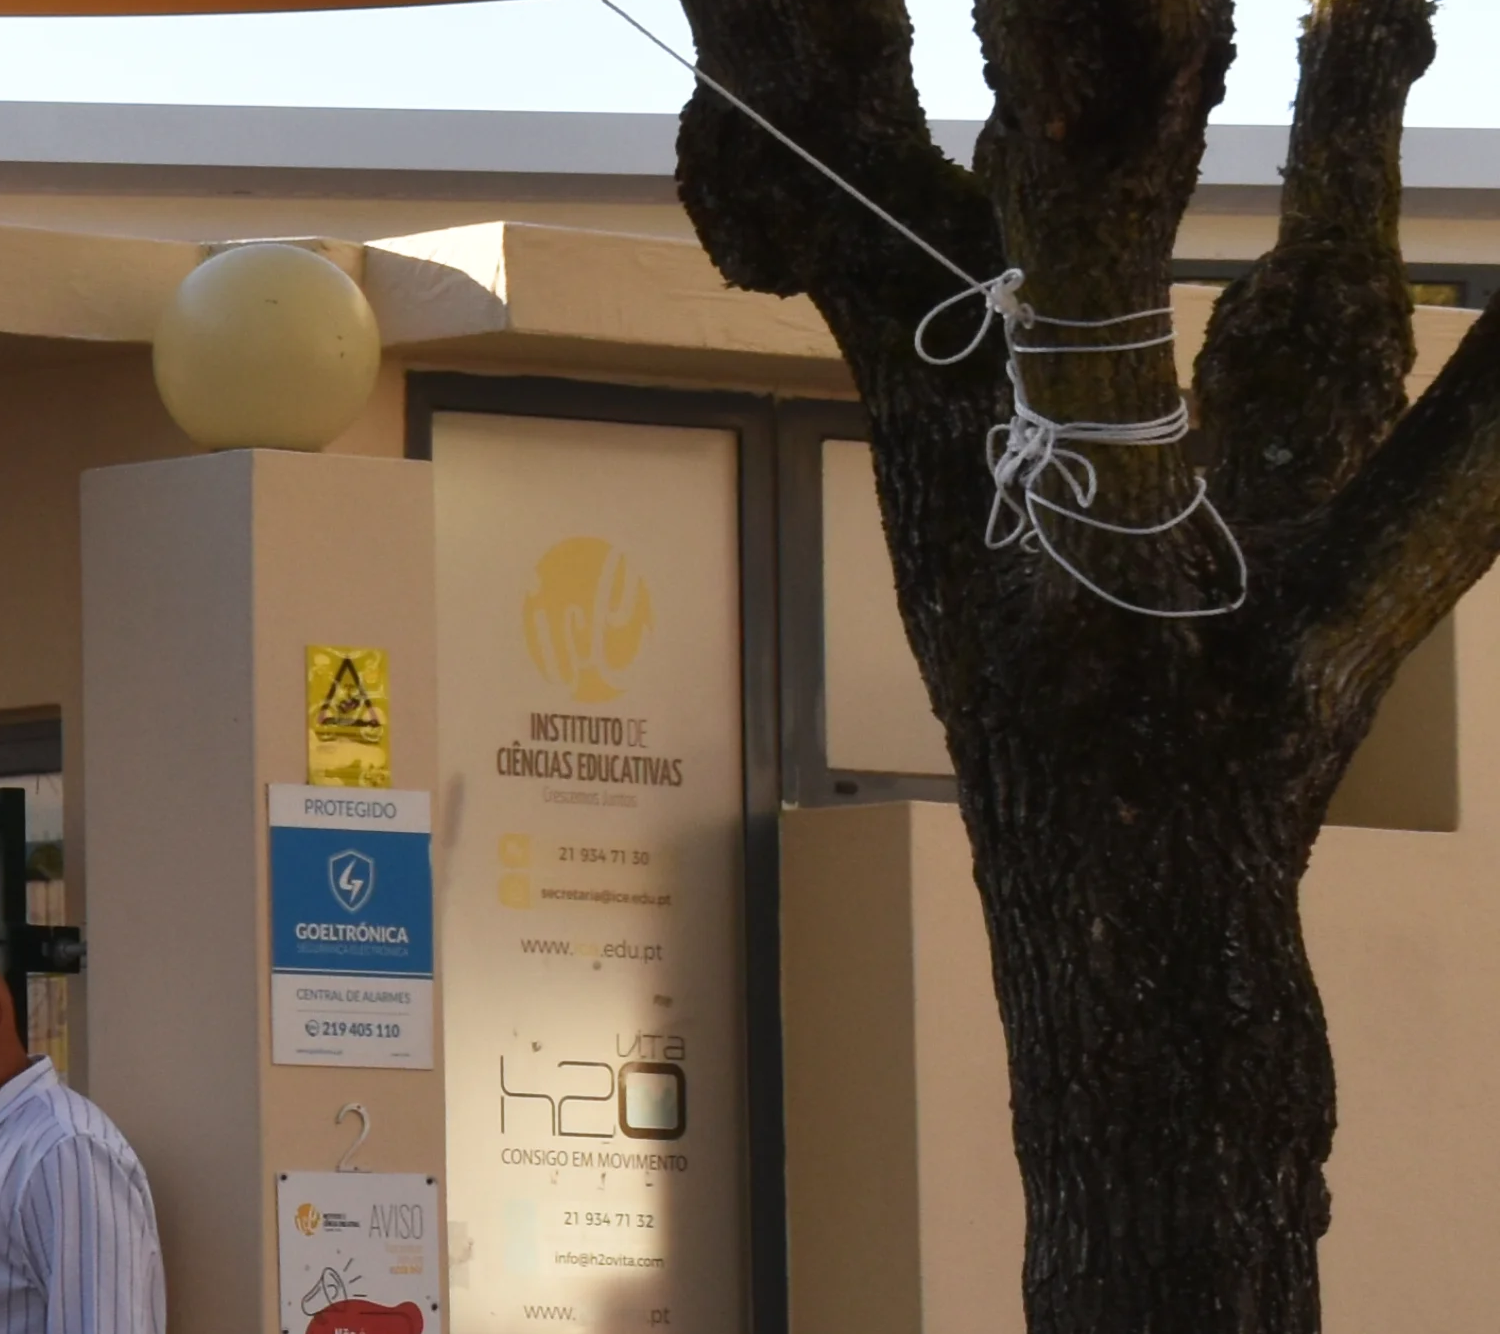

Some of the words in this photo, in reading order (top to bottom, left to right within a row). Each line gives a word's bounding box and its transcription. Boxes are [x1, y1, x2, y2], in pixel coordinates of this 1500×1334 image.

[530, 712, 623, 746] INSTITUTO
[627, 718, 648, 748] DE
[496, 740, 572, 780] CIÊNCIAS
[577, 752, 682, 787] EDUCATIVAS
[304, 798, 397, 819] PROTEGIDO
[558, 846, 575, 861] 21
[579, 847, 606, 862] 934
[610, 849, 626, 864] 71
[631, 850, 650, 865] 30
[541, 888, 672, 907] secretaria@ice.edu.pt
[295, 921, 409, 944] GOELTRÓNICA
[296, 988, 344, 1002] CENTRAL
[346, 989, 361, 1002] DE
[363, 990, 411, 1005] ALARMES
[322, 1021, 347, 1036] 219
[350, 1022, 373, 1038] 405
[376, 1023, 400, 1038] 110
[501, 1148, 568, 1166] CONSIGO
[572, 1151, 593, 1167] EM
[598, 1152, 688, 1172] MOVIMENTO
[368, 1204, 423, 1240] AVISO
[564, 1212, 579, 1225] 21
[585, 1212, 611, 1226] 934
[615, 1213, 631, 1227] 71
[636, 1214, 654, 1228] 32
[554, 1251, 665, 1268] info@h2ovita.com
